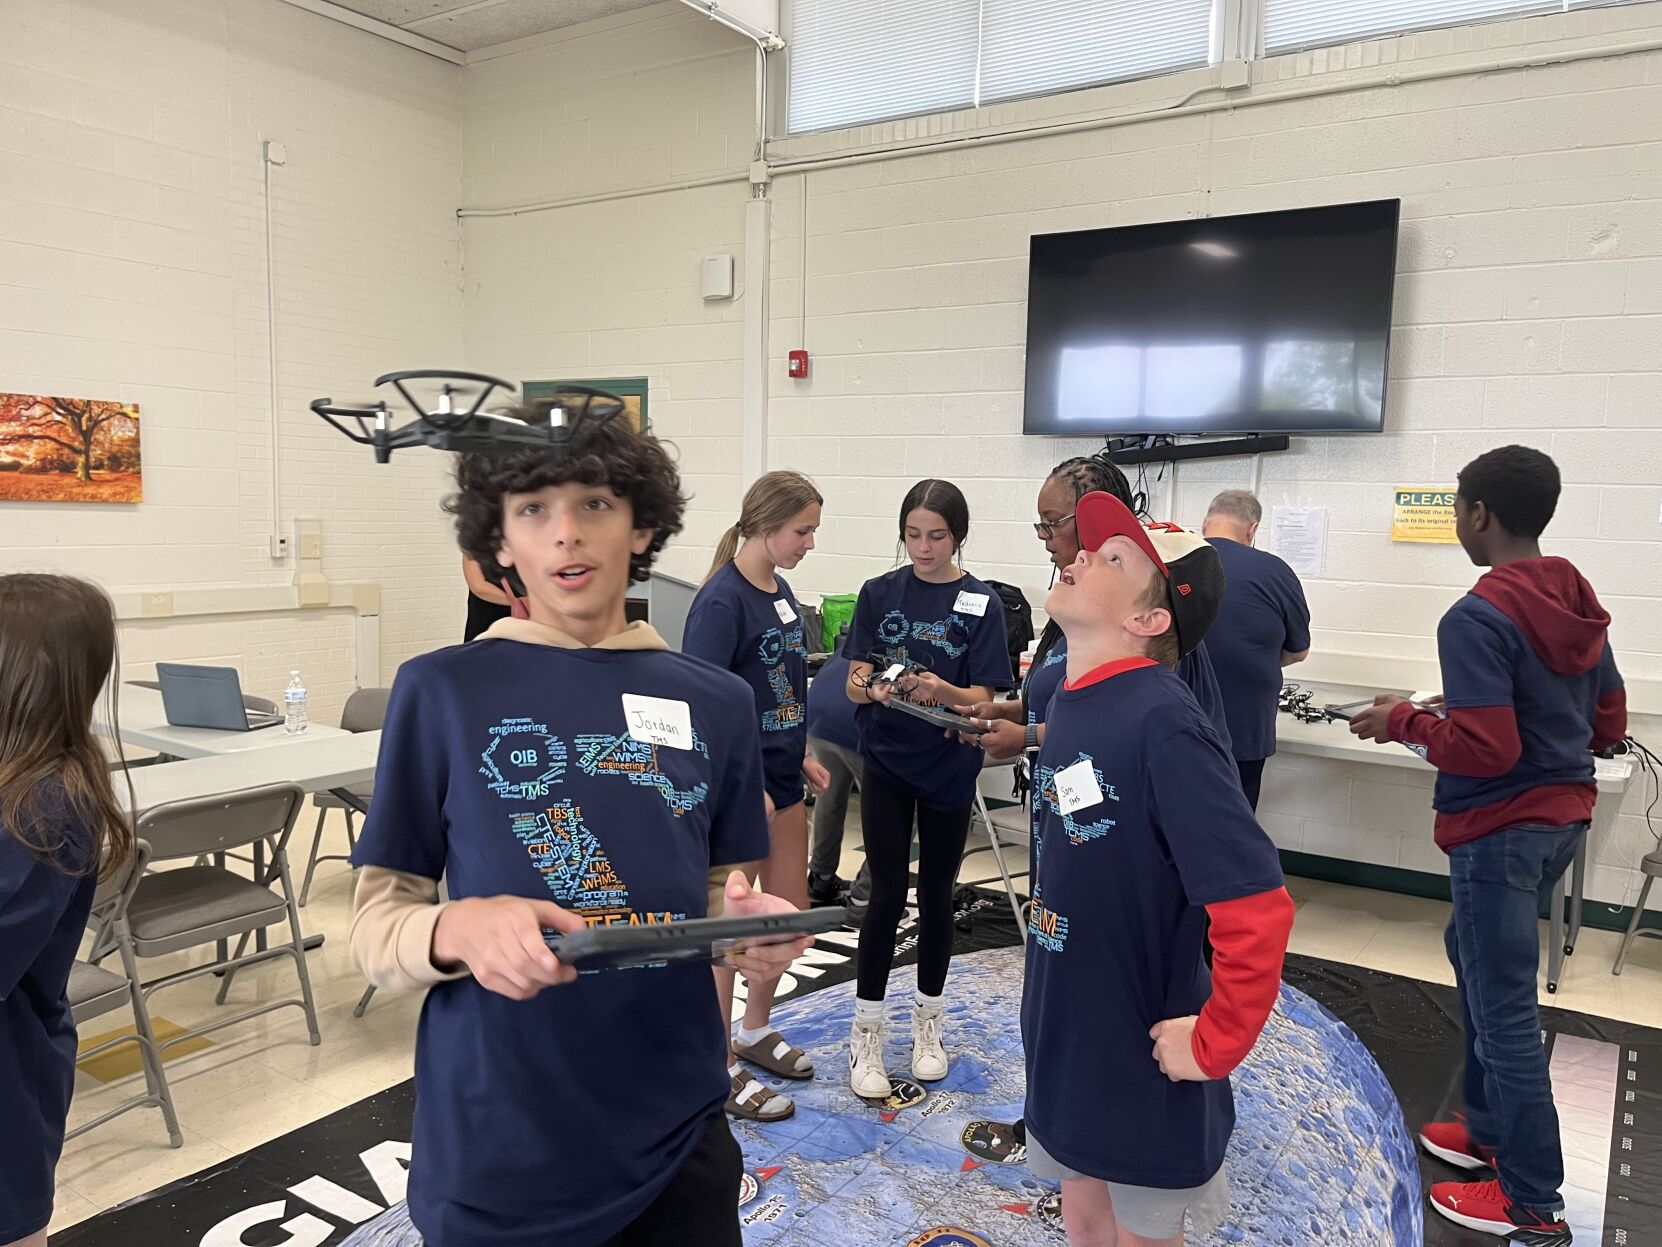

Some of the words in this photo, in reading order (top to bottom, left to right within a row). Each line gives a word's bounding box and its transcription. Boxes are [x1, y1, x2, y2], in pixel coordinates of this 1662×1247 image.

[1400, 494, 1455, 506] PLEAS
[488, 722, 548, 736] engineering
[631, 710, 680, 736] Jordan
[650, 735, 669, 745] TMS
[579, 742, 601, 767] EIMS
[622, 741, 652, 755] NIMS
[510, 749, 538, 765] OIB
[612, 752, 647, 763] WIMS
[597, 759, 646, 772] engineering
[628, 773, 667, 784] science
[519, 783, 549, 798] TMS
[661, 786, 675, 799] OIB
[1100, 782, 1116, 795] CTE
[665, 797, 693, 811] TCMS
[546, 803, 568, 820] TBS
[1100, 818, 1116, 826] robot
[553, 825, 571, 841] robot
[567, 802, 582, 861] technology
[1065, 828, 1089, 842] TCMS
[528, 844, 550, 855] CTE
[589, 861, 611, 873] LMS
[582, 871, 617, 890] WHMS
[583, 889, 623, 901] program
[921, 1099, 942, 1117] Apollo
[939, 1091, 949, 1101] 17
[964, 1122, 981, 1143] APOLLO
[1620, 1163, 1631, 1177] 1000
[743, 1204, 771, 1225] Apollo
[764, 1204, 788, 1222] 1971
